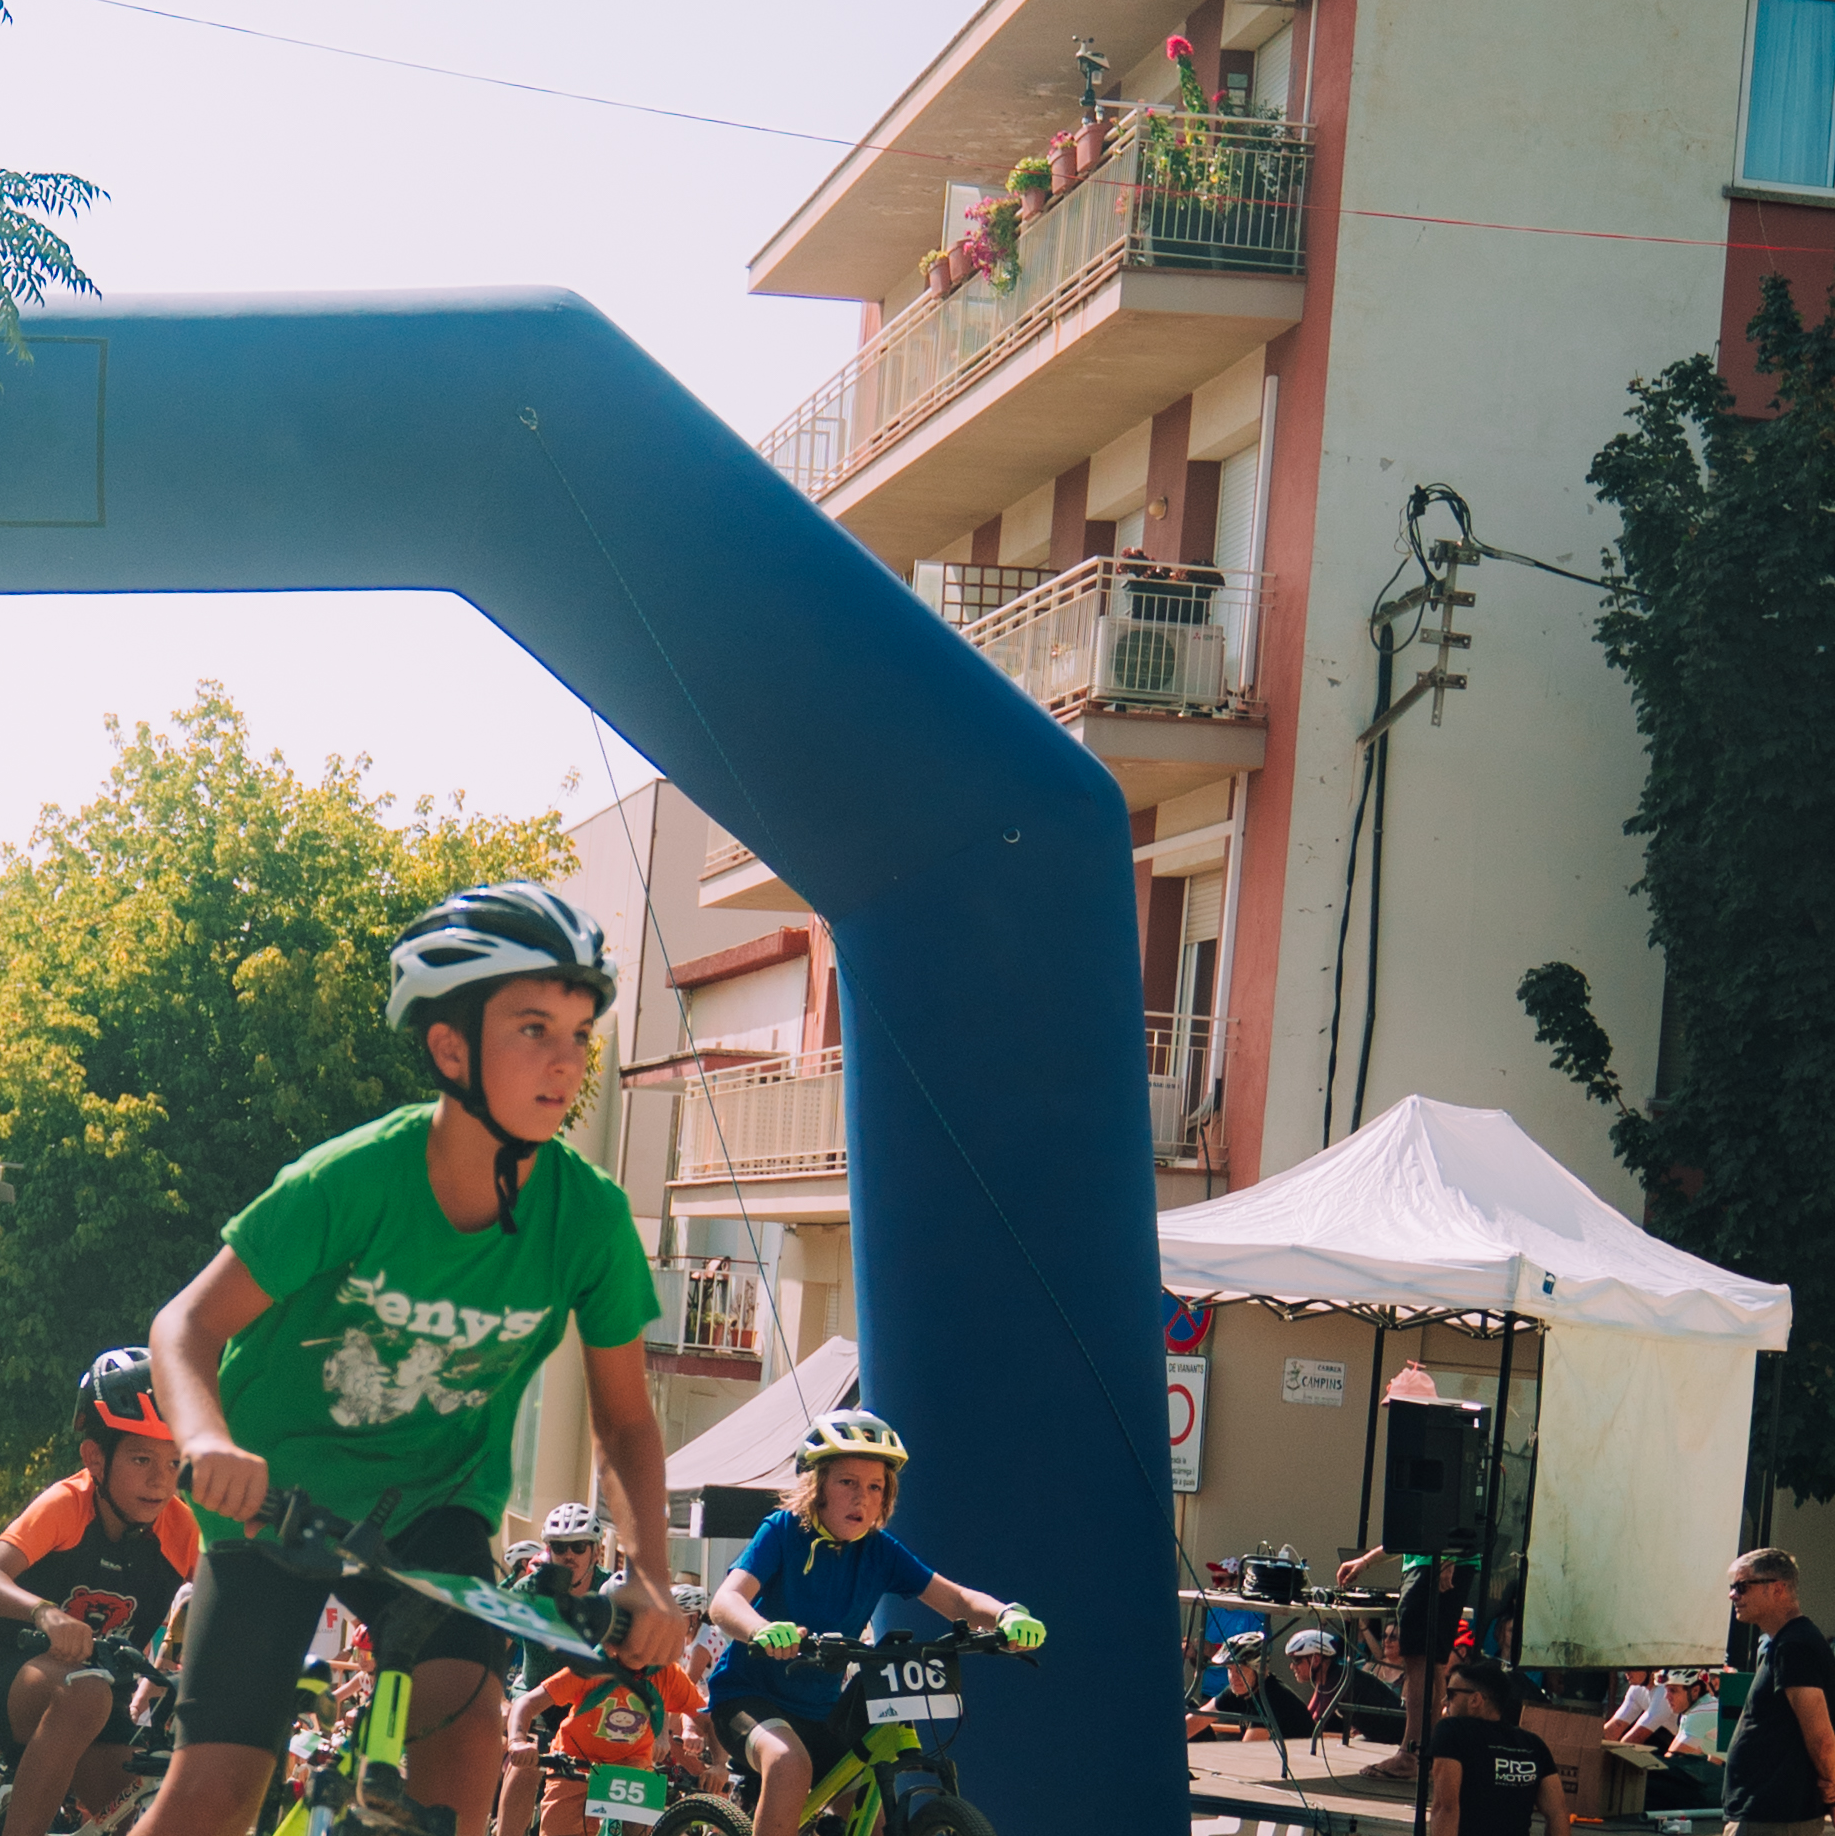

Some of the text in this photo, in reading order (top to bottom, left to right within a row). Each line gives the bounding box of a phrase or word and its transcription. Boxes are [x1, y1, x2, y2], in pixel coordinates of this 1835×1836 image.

[1301, 1376, 1342, 1390] CAMPINS
[880, 1659, 946, 1692] 106
[1495, 1757, 1537, 1774] PRO
[1495, 1773, 1537, 1782] MOTOR
[608, 1778, 645, 1804] 55
